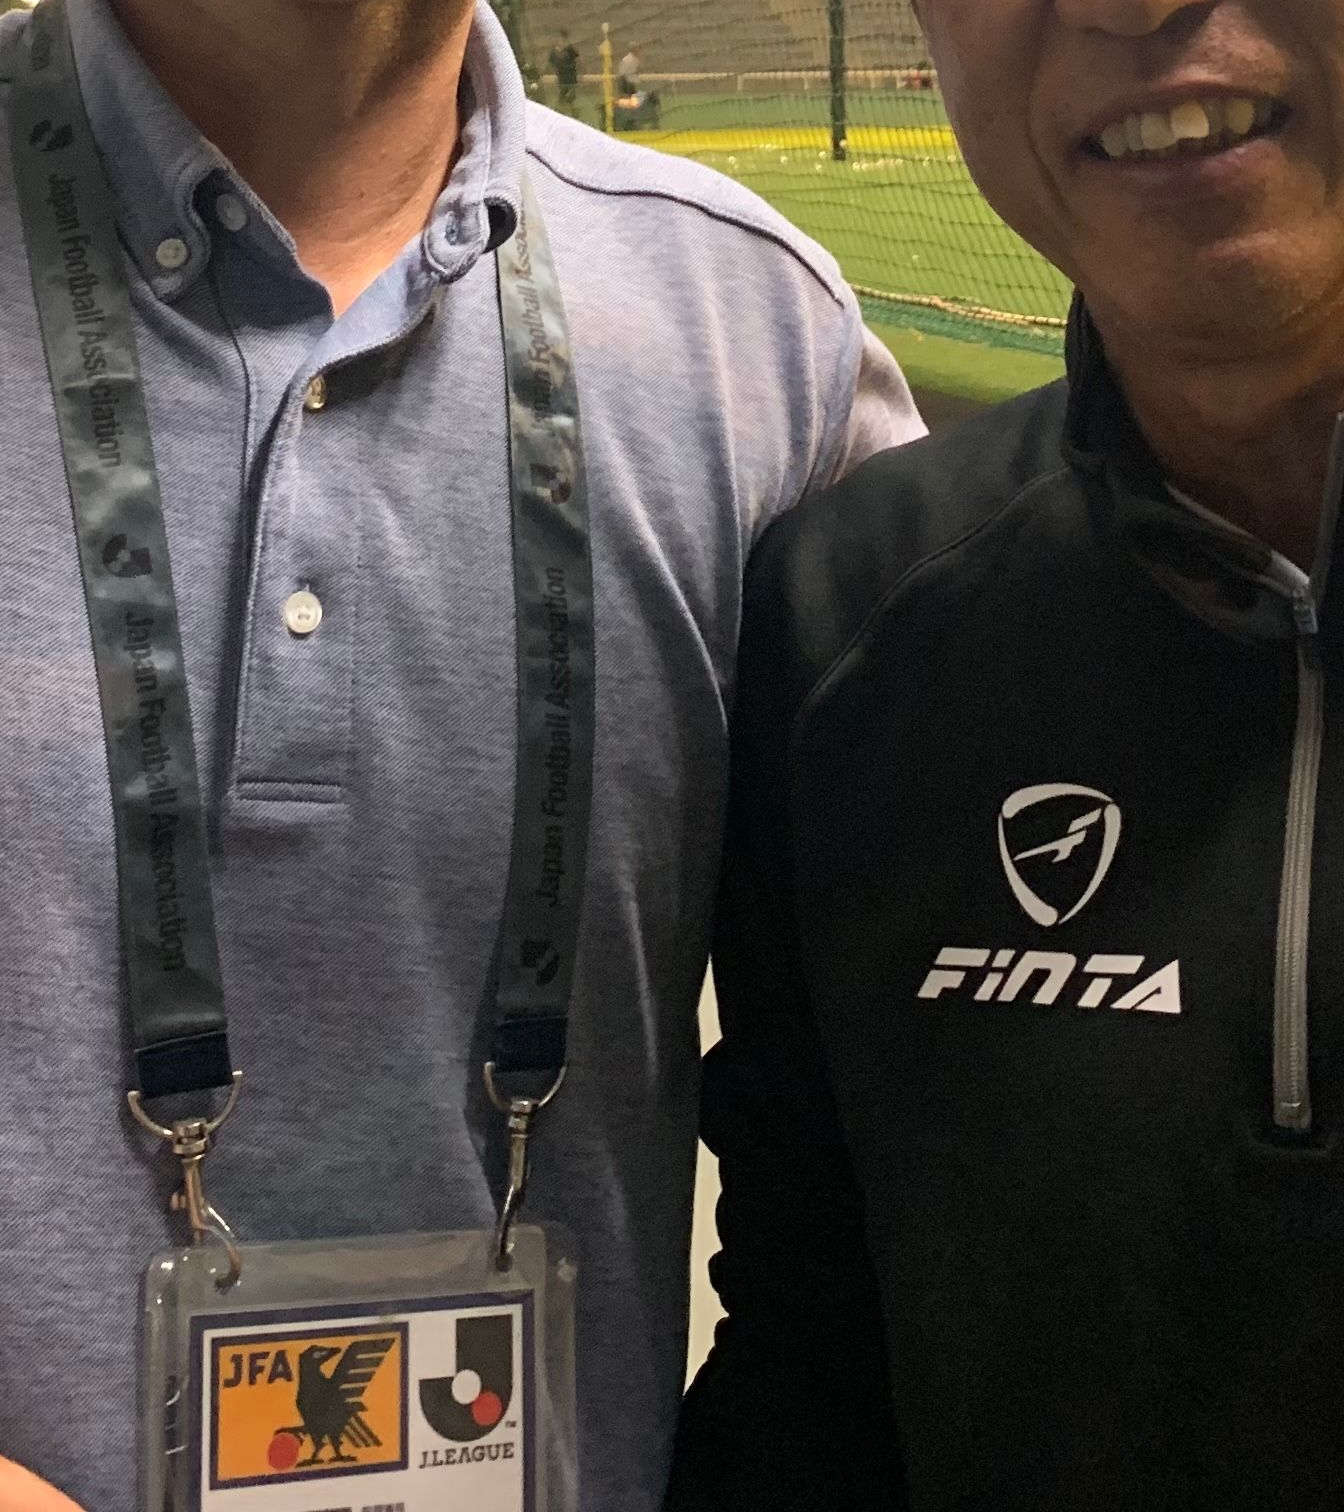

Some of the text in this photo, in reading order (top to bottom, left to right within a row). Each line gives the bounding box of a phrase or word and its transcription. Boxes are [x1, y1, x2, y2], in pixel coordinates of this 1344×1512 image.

[44, 174, 80, 233] Japan
[61, 234, 106, 326] Football
[516, 284, 551, 365] Football
[139, 698, 177, 806] Football
[536, 568, 573, 908] Japan Football Association
[149, 813, 187, 972] Association
[223, 1350, 293, 1388] JFA
